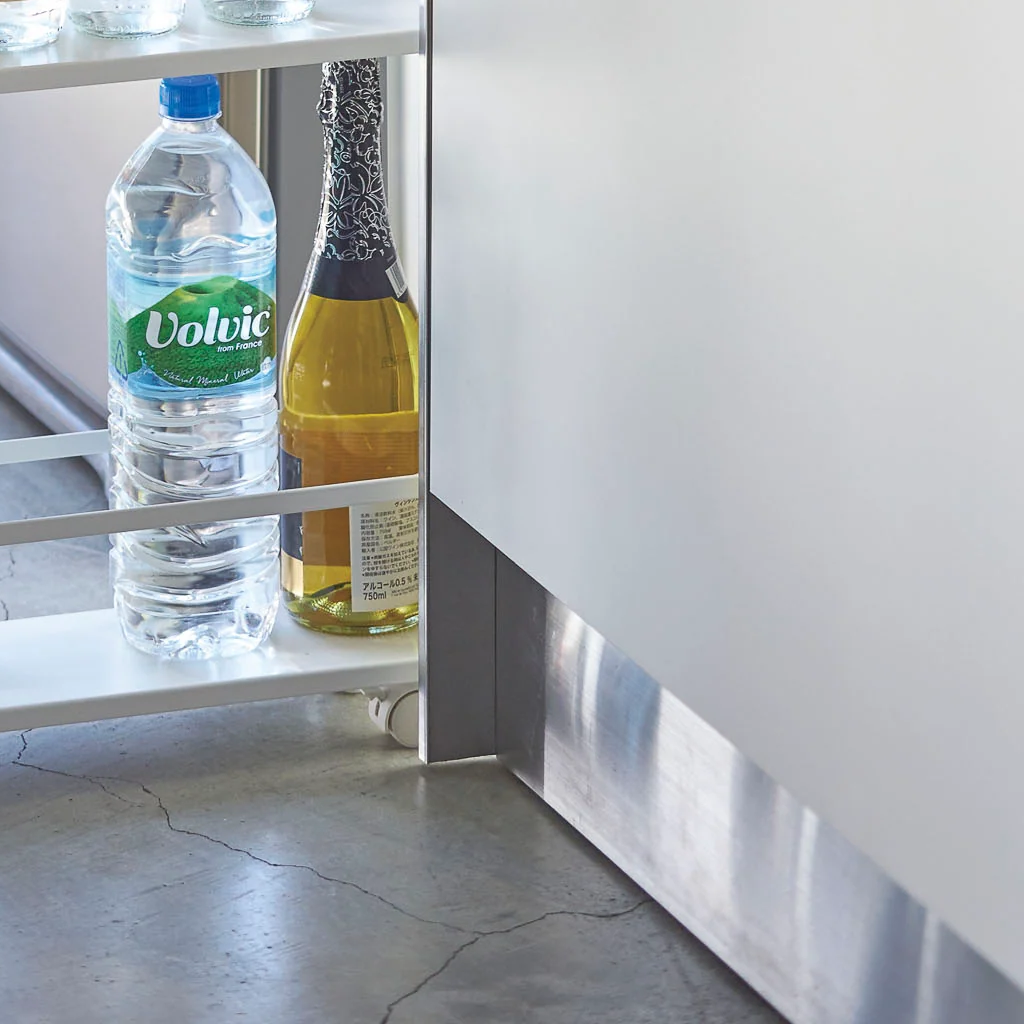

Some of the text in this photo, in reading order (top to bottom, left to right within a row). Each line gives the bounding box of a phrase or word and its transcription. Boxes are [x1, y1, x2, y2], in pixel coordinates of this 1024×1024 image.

[145, 305, 271, 349] Volvic
[217, 340, 263, 353] from France
[163, 368, 255, 387] Natural Mineral Water
[362, 591, 387, 601] 750ml
